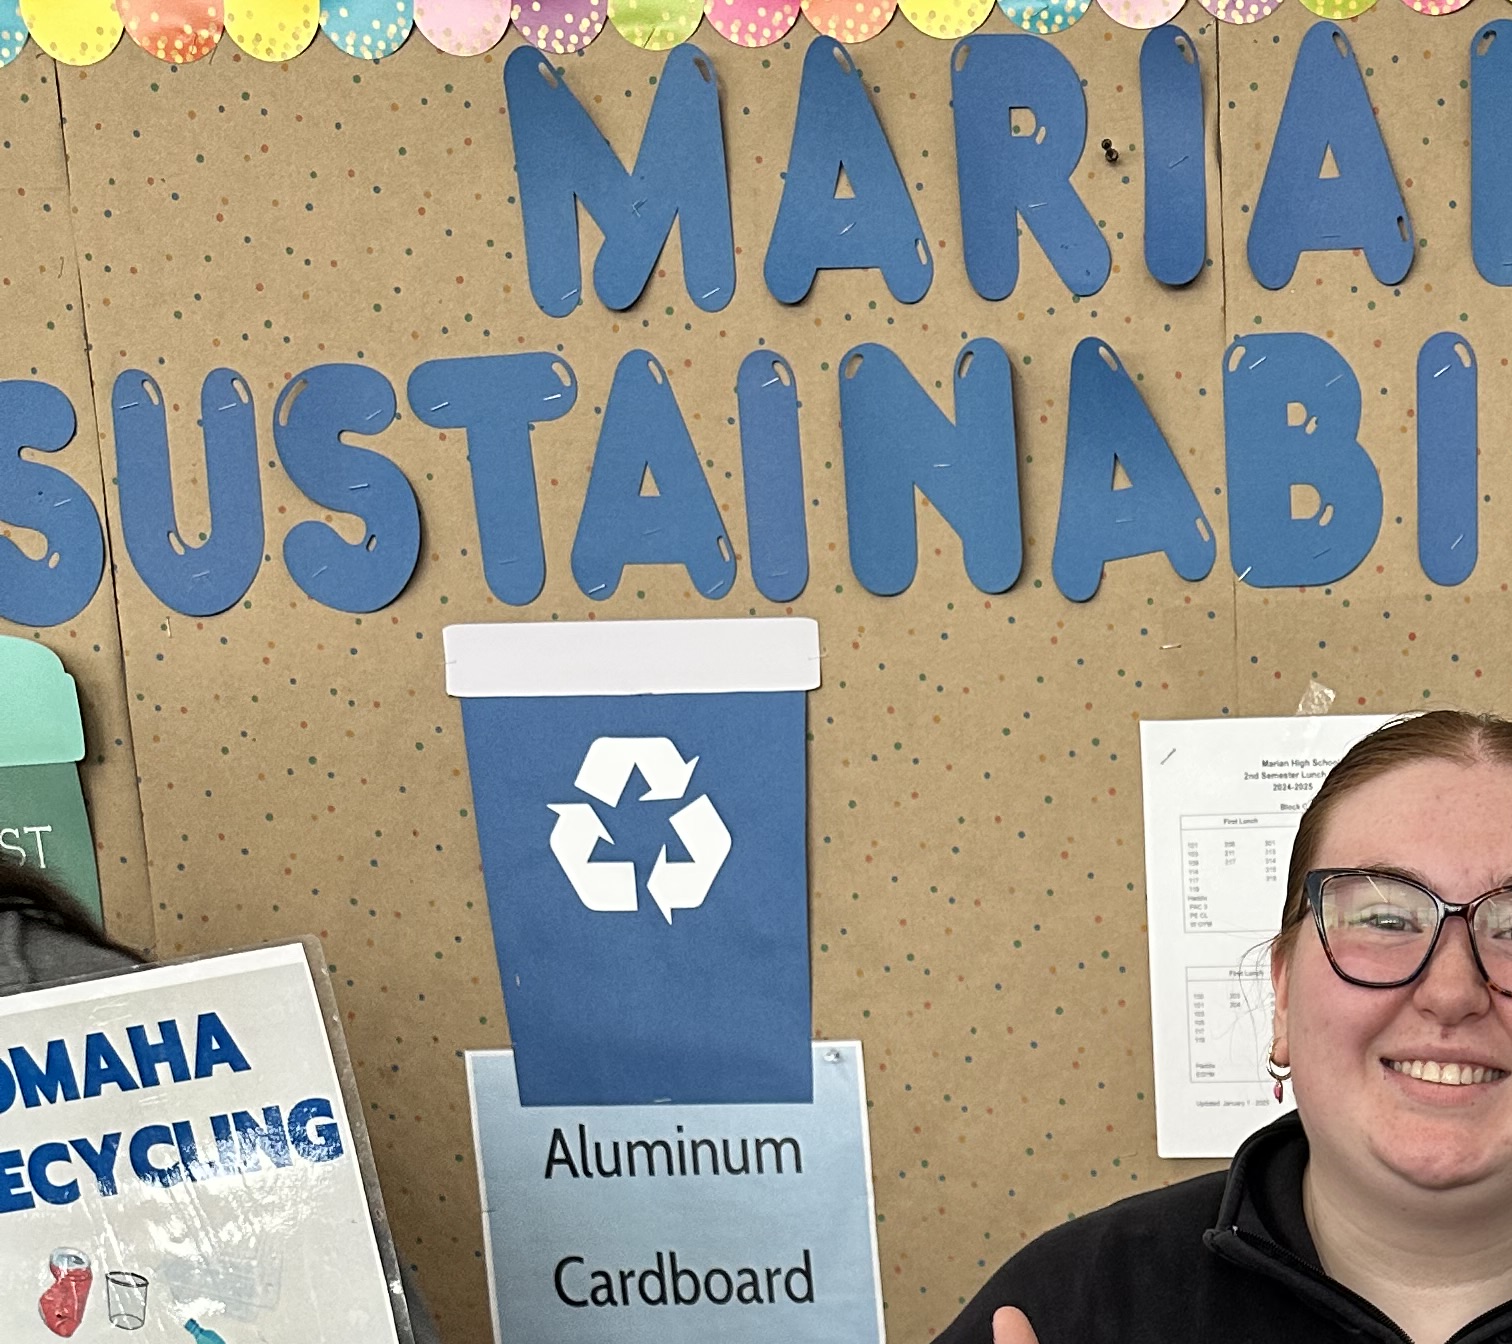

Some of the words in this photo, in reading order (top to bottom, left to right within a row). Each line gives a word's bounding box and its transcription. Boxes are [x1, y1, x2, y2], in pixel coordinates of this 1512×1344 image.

[1261, 771, 1299, 779] Semester
[1301, 771, 1326, 779] Lunch
[1273, 783, 1313, 791] 2024-2025
[1291, 759, 1310, 768] High
[0, 1012, 251, 1114] MAHA
[0, 1098, 344, 1214] ECYCLING
[544, 1123, 803, 1179] Aluminum
[553, 1249, 816, 1308] Cardboard
